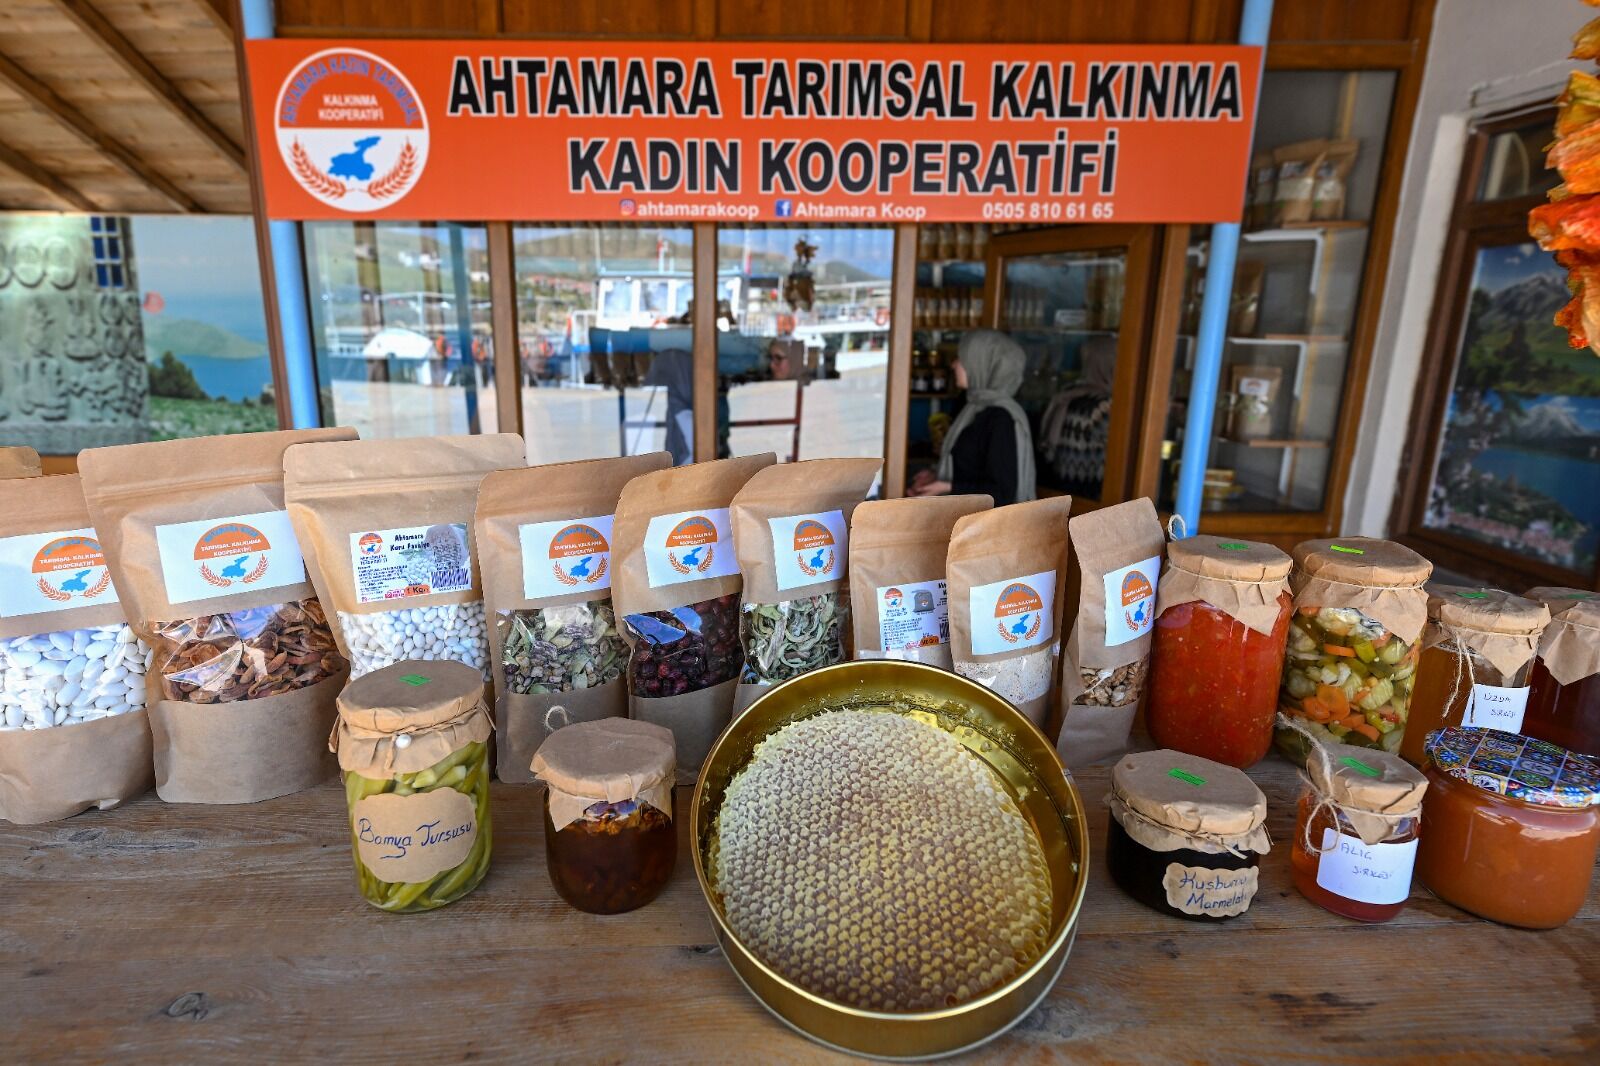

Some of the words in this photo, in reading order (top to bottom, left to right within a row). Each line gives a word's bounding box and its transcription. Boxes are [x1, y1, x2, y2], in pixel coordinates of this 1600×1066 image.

[449, 57, 723, 117] AHTAMARA
[733, 60, 976, 120] TARIMSAL
[989, 62, 1243, 121] KALKINMA
[322, 94, 378, 107] KALKINMA
[567, 138, 742, 194] KADIN
[759, 128, 1119, 195] KOOPERATİFİ
[637, 202, 760, 221] ahtamarakoop
[795, 203, 876, 218] Ahtamara
[881, 203, 927, 221] Koop
[982, 202, 1025, 219] 0505
[1029, 202, 1061, 219] 810
[1066, 202, 1086, 219] 61
[1092, 202, 1114, 219] 65
[359, 818, 412, 860] Bamya
